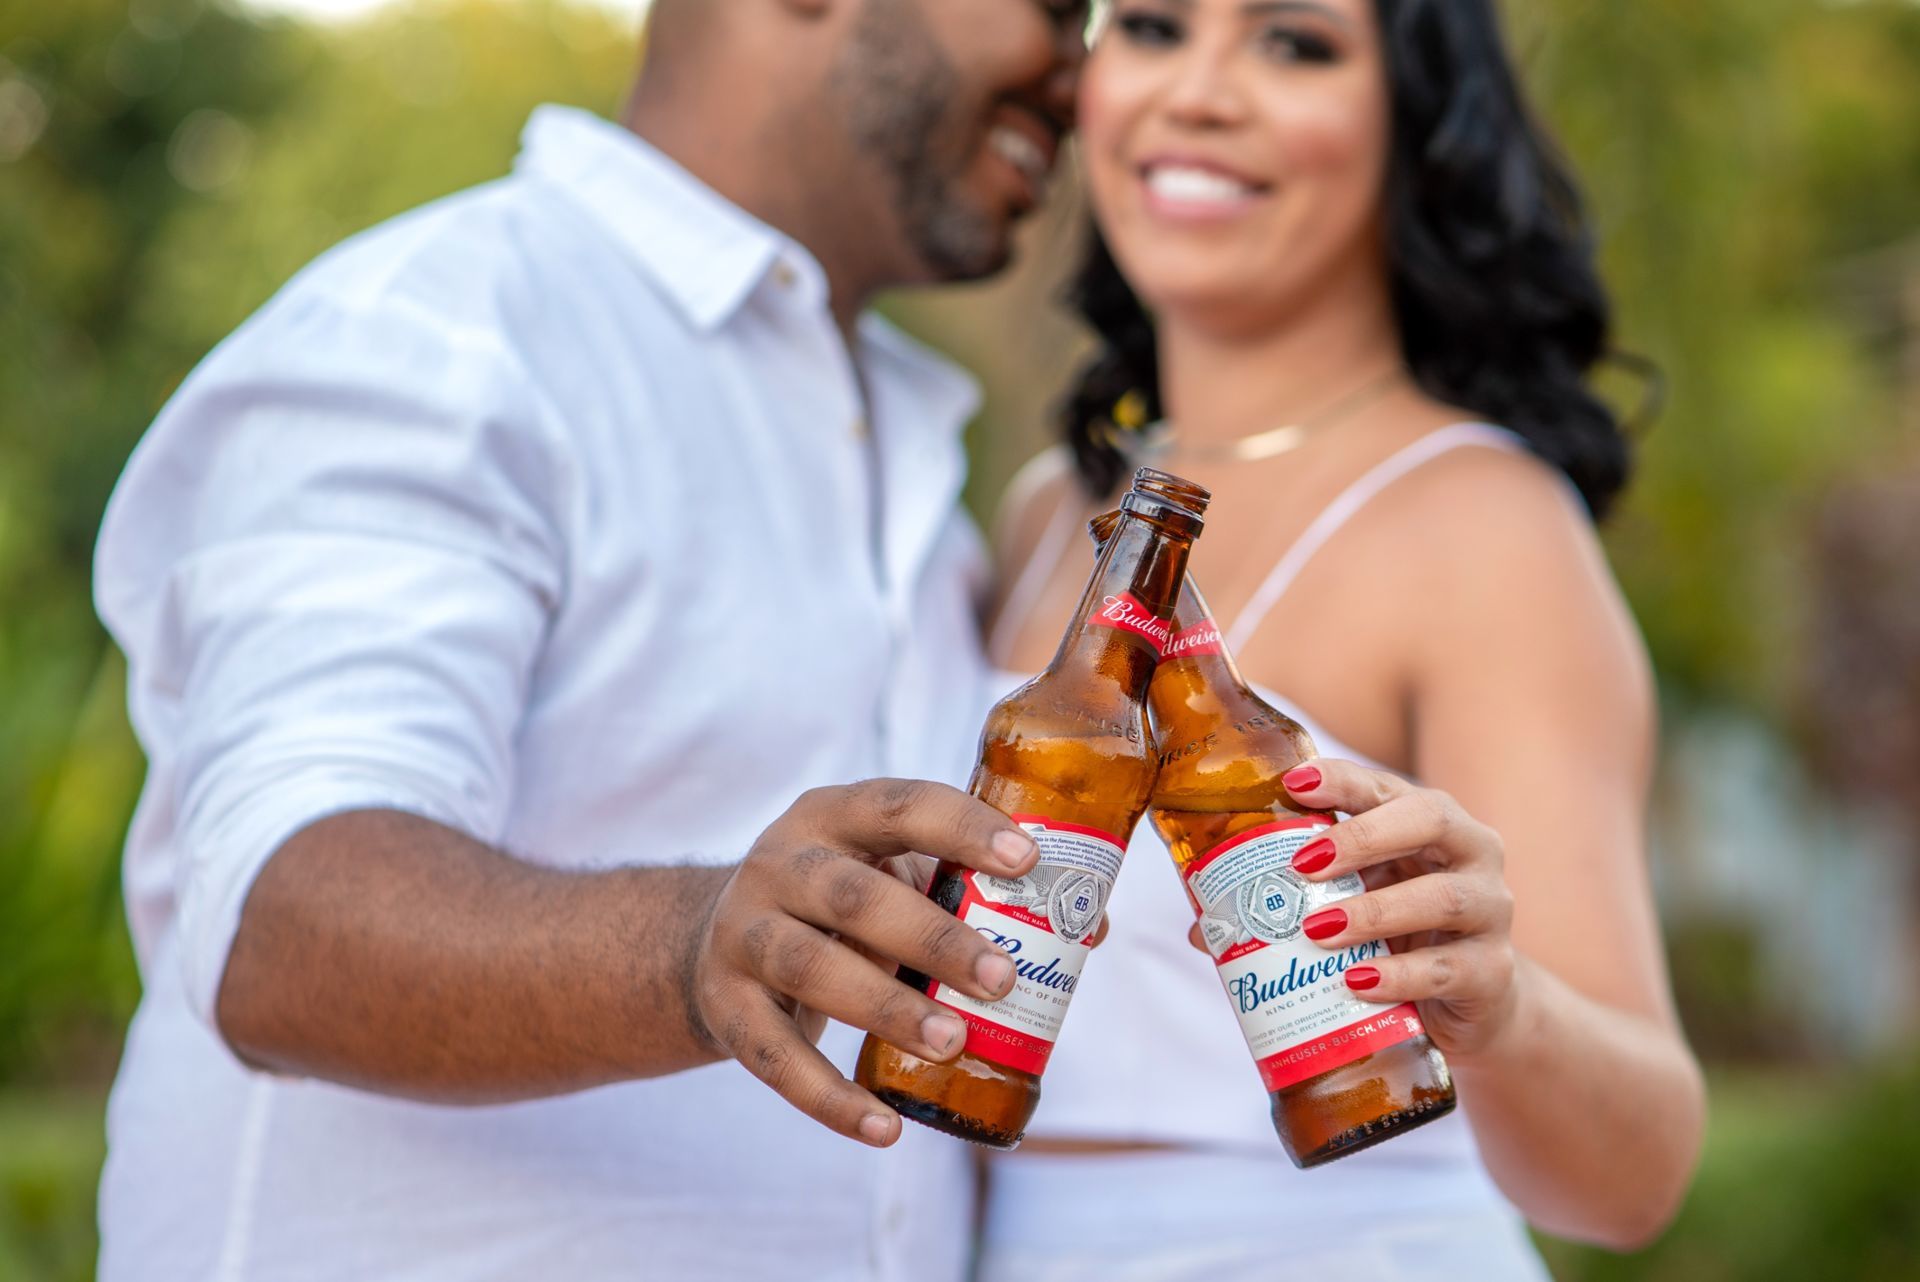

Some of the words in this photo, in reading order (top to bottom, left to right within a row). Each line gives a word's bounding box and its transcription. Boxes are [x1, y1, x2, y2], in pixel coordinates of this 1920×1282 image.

[1161, 628, 1221, 656] dweiser
[1012, 910, 1030, 922] TRADE
[1032, 918, 1047, 928] MARK
[1229, 939, 1381, 1014] Budweiser
[1016, 984, 1031, 995] NG
[1036, 990, 1050, 1000] OF
[1052, 996, 1069, 1007] BEE
[1265, 1000, 1294, 1016] KING
[1300, 990, 1318, 1003] OF
[1322, 981, 1345, 994] BEE
[1017, 1016, 1032, 1026] RICE
[1034, 1020, 1046, 1030] AND
[1018, 1006, 1048, 1020] ORIGINAL
[1278, 1022, 1293, 1032] OUR
[1294, 1006, 1332, 1025] ORIGINAL
[1300, 1022, 1318, 1033] RICE
[1320, 1012, 1338, 1024] AND
[964, 1018, 1050, 1056] ANHEUSER-BUSC
